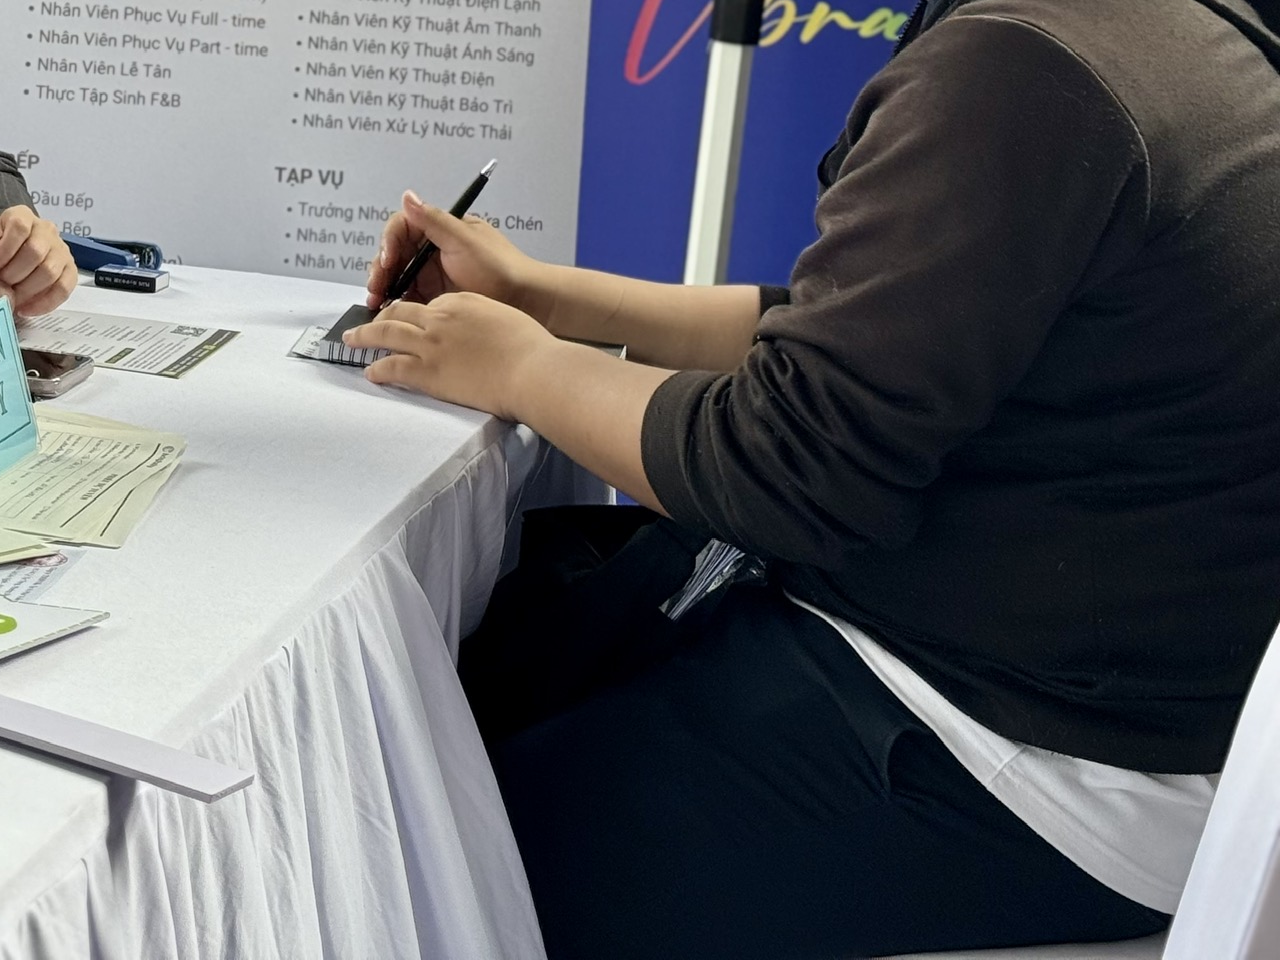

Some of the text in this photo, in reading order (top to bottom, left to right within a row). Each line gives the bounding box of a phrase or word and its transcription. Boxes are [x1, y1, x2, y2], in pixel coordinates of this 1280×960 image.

[41, 2, 266, 29] Nhân Viên Phục Vụ Full time
[309, 10, 541, 38] Nhân Viên Kỹ Thuật Âm Thanh
[39, 30, 269, 57] Nhân Viên Phục Vụ Part time
[308, 36, 534, 67] Nhân Viên Kỹ Thuật Ánh Sáng
[37, 58, 172, 78] Nhân Viên Lễ Tân
[306, 62, 494, 88] Nhân Viên Kỹ Thuật Điện
[36, 85, 180, 107] Thực Tập Sinh F&B
[305, 88, 513, 114] Nhân Viên Kỹ Thuật Bảo Trì
[303, 114, 512, 140] Nhân Viên Xử Lý Nước Thải
[16, 150, 40, 169] ẾP
[275, 166, 343, 189] TẠP VỤ
[31, 190, 93, 211] Đầu Bếp
[298, 202, 353, 222] Trưởng
[505, 215, 543, 231] Chén
[63, 222, 91, 237] Bếp
[297, 229, 374, 246] Nhân Viên
[295, 254, 371, 271] Nhân Viên
